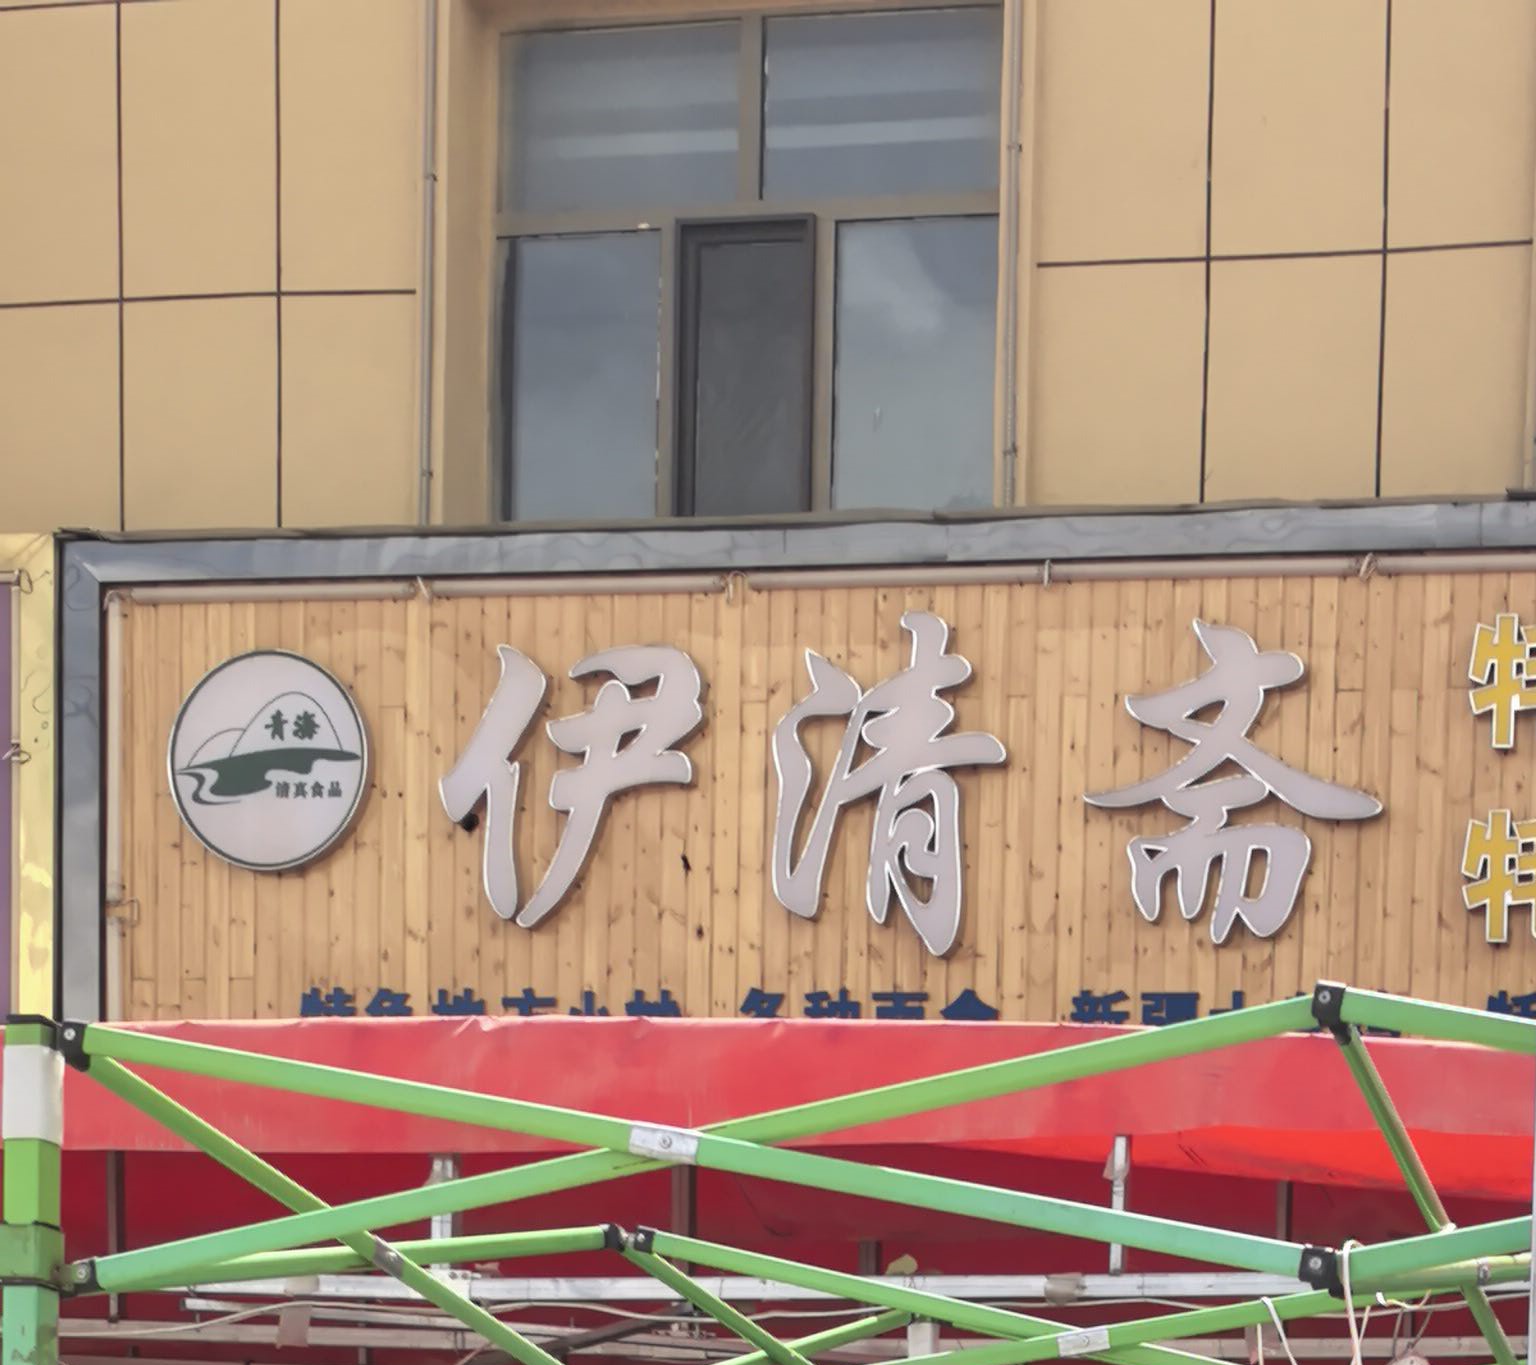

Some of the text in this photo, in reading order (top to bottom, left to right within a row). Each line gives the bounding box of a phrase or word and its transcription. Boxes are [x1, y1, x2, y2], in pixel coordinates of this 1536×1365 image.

[264, 709, 320, 741] 青海
[438, 611, 1383, 958] 伊清斋
